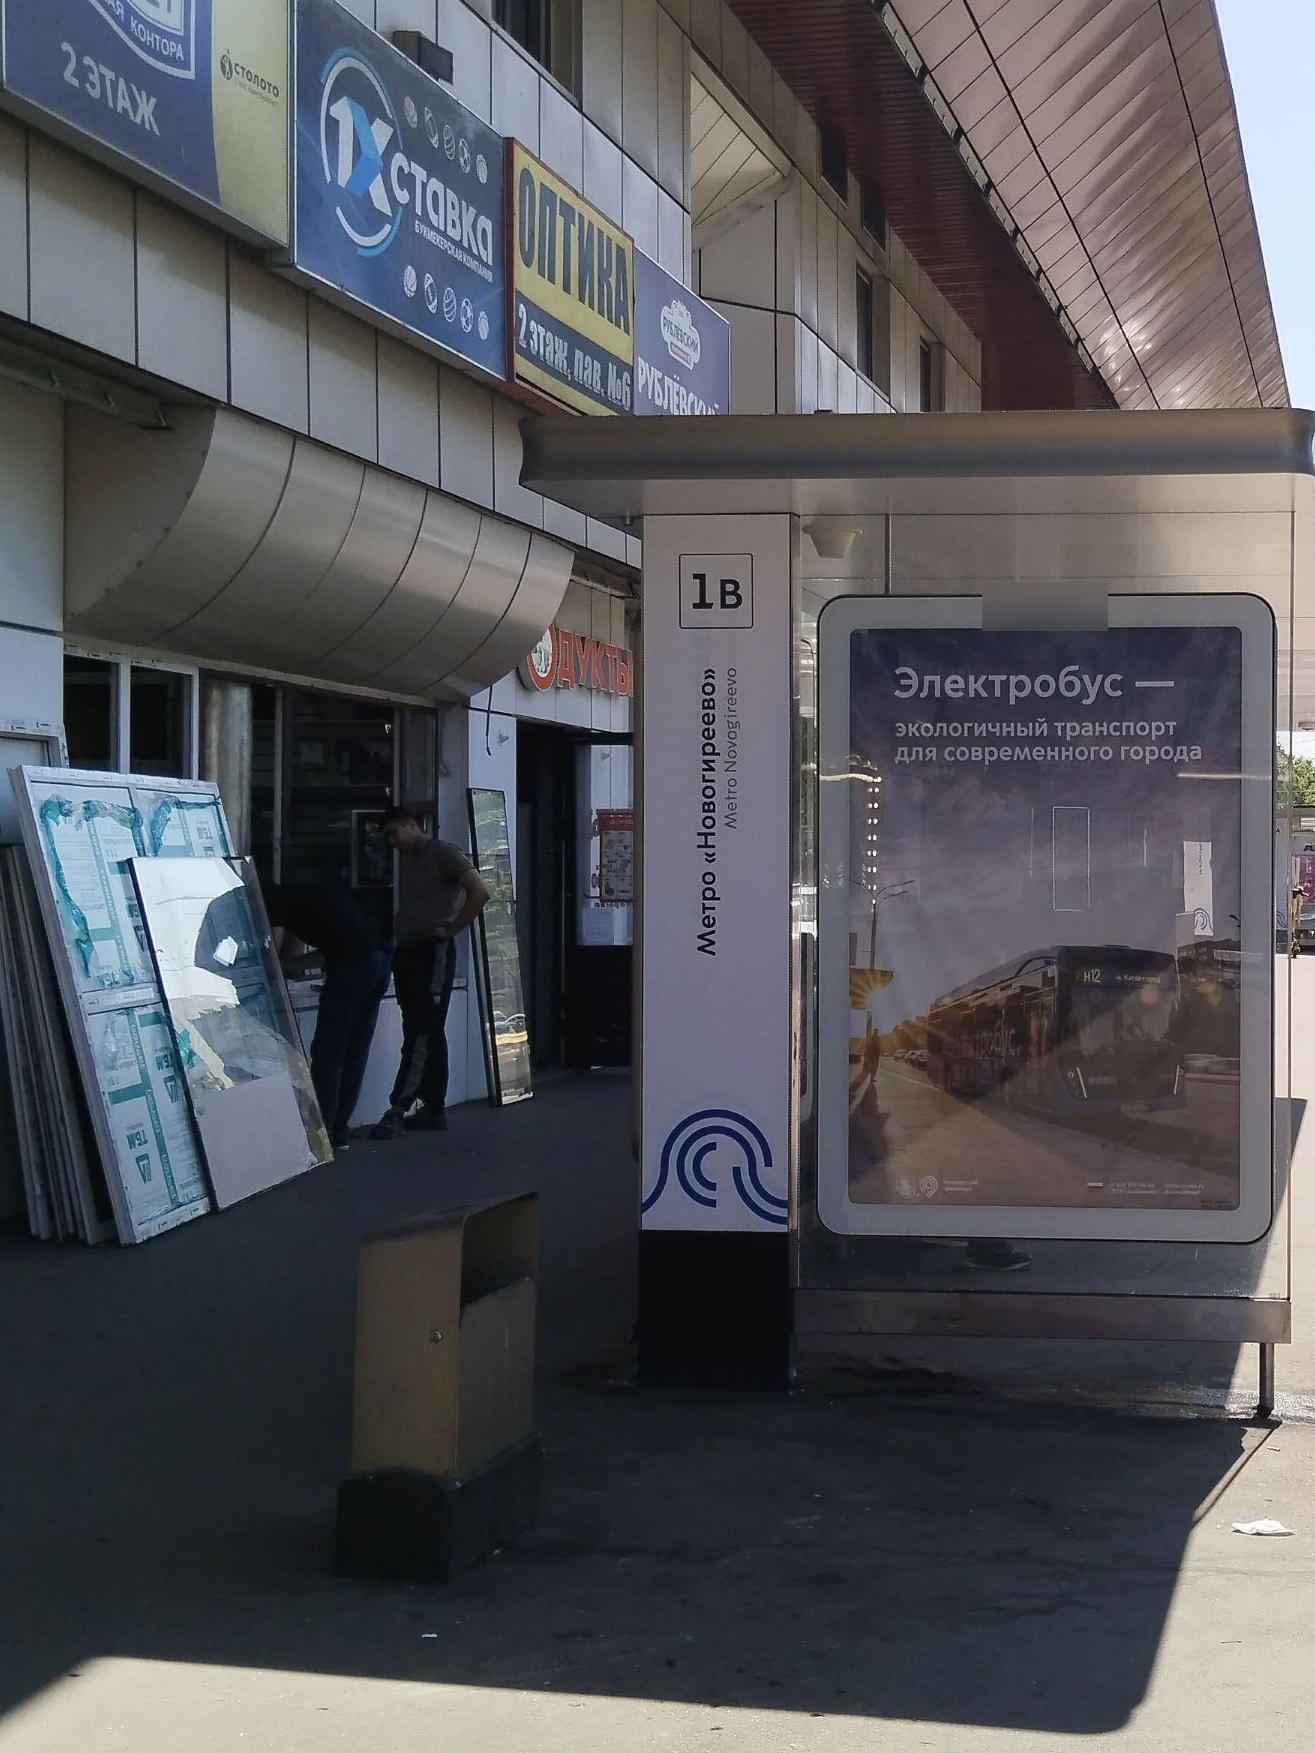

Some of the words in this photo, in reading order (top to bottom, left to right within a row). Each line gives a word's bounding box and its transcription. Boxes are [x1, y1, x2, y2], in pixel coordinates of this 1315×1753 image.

[130, 16, 184, 61] КОНТОРА
[61, 42, 80, 89] 2
[83, 56, 161, 137] ЭТАЖ
[518, 167, 631, 337] ОПТИКА
[518, 303, 529, 350] 2
[574, 347, 605, 398] пав.
[608, 362, 631, 412] №6
[724, 666, 742, 775] Novogireevo
[893, 664, 1124, 706] Электробус
[894, 716, 1048, 738] экологичный
[1053, 719, 1178, 741] транспорт
[696, 667, 721, 865] «Новогиреево»
[894, 745, 937, 765] для
[943, 744, 1114, 766] современного
[1119, 744, 1202, 766] города
[724, 777, 739, 831] Metro
[696, 869, 721, 957] Метро
